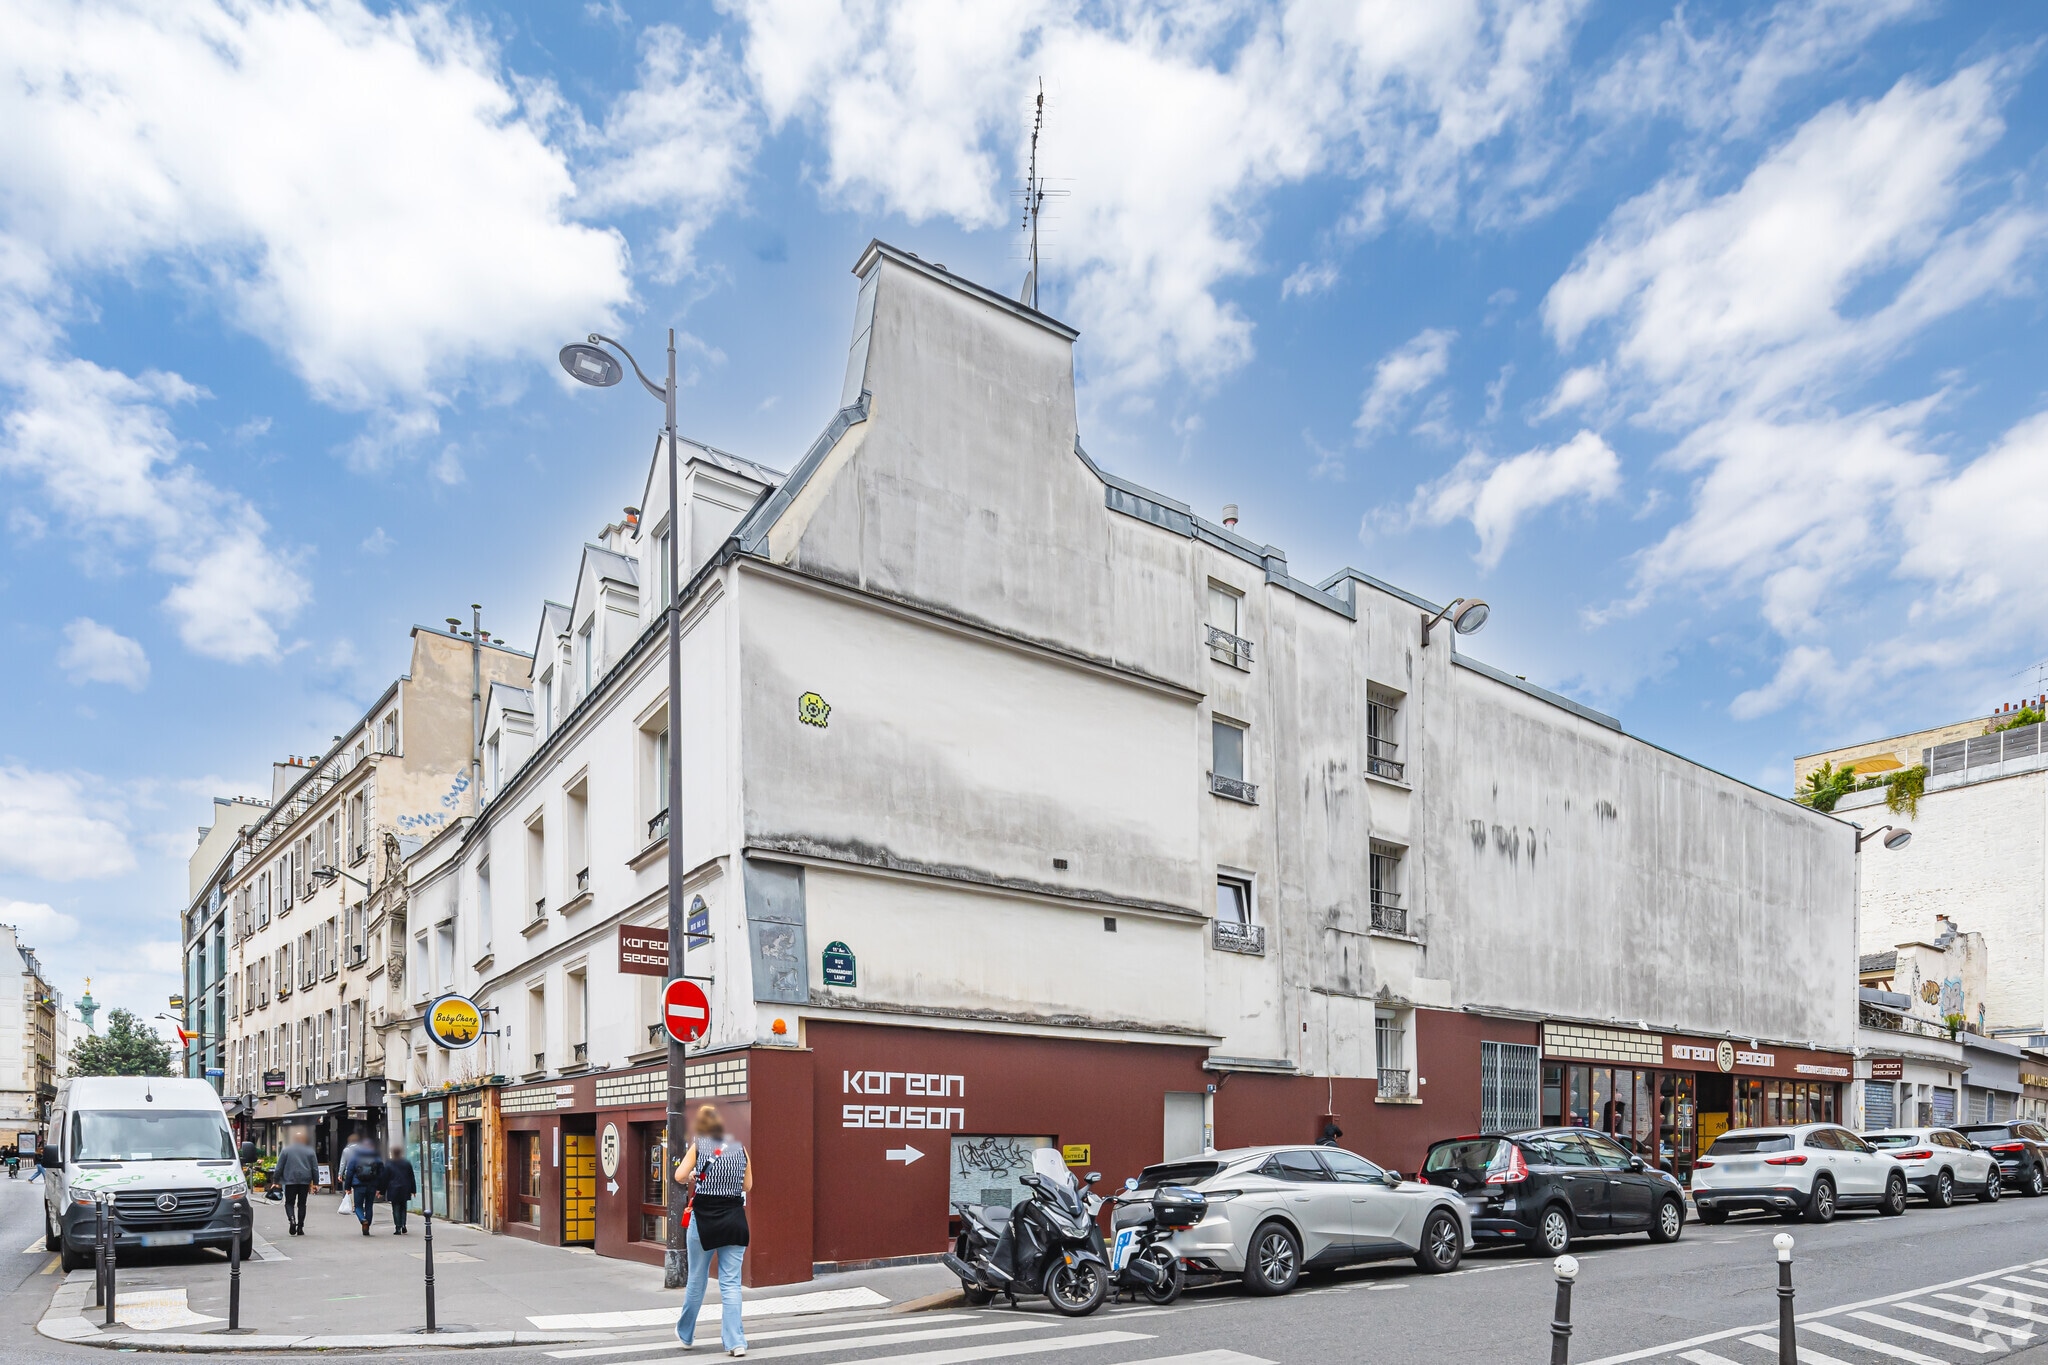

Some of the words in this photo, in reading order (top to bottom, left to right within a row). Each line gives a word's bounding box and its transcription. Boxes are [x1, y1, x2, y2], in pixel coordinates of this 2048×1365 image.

[623, 937, 669, 951] Korea
[623, 952, 669, 966] seaso
[436, 1012, 455, 1025] Baby
[455, 1013, 478, 1025] Chang
[843, 1070, 965, 1097] Korean
